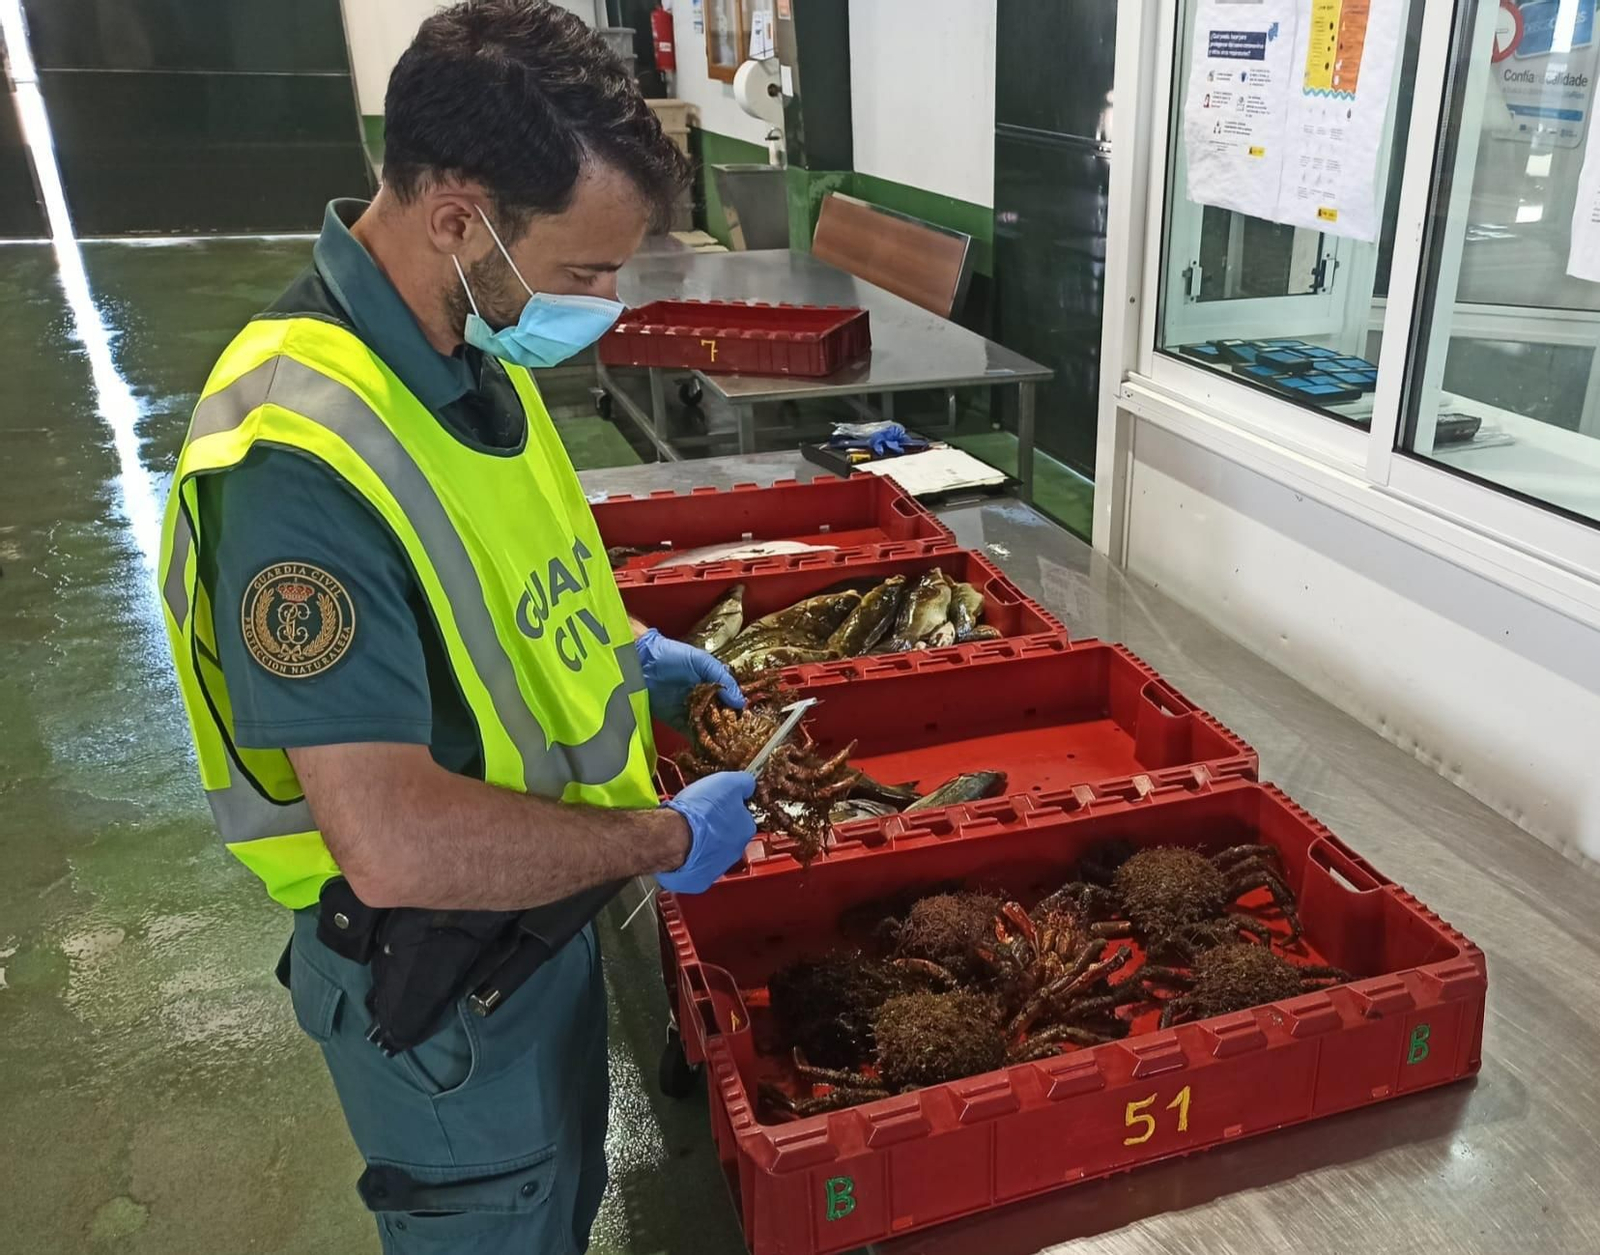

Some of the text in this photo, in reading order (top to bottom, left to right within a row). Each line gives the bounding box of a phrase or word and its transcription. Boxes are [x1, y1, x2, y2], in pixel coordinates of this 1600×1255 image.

[701, 339, 718, 362] 7
[254, 565, 342, 598] GUARDIA CIVIL
[291, 626, 351, 674] NATURALEZA
[1407, 1024, 1430, 1064] B
[1124, 1085, 1191, 1146] 51
[825, 1175, 856, 1221] B
